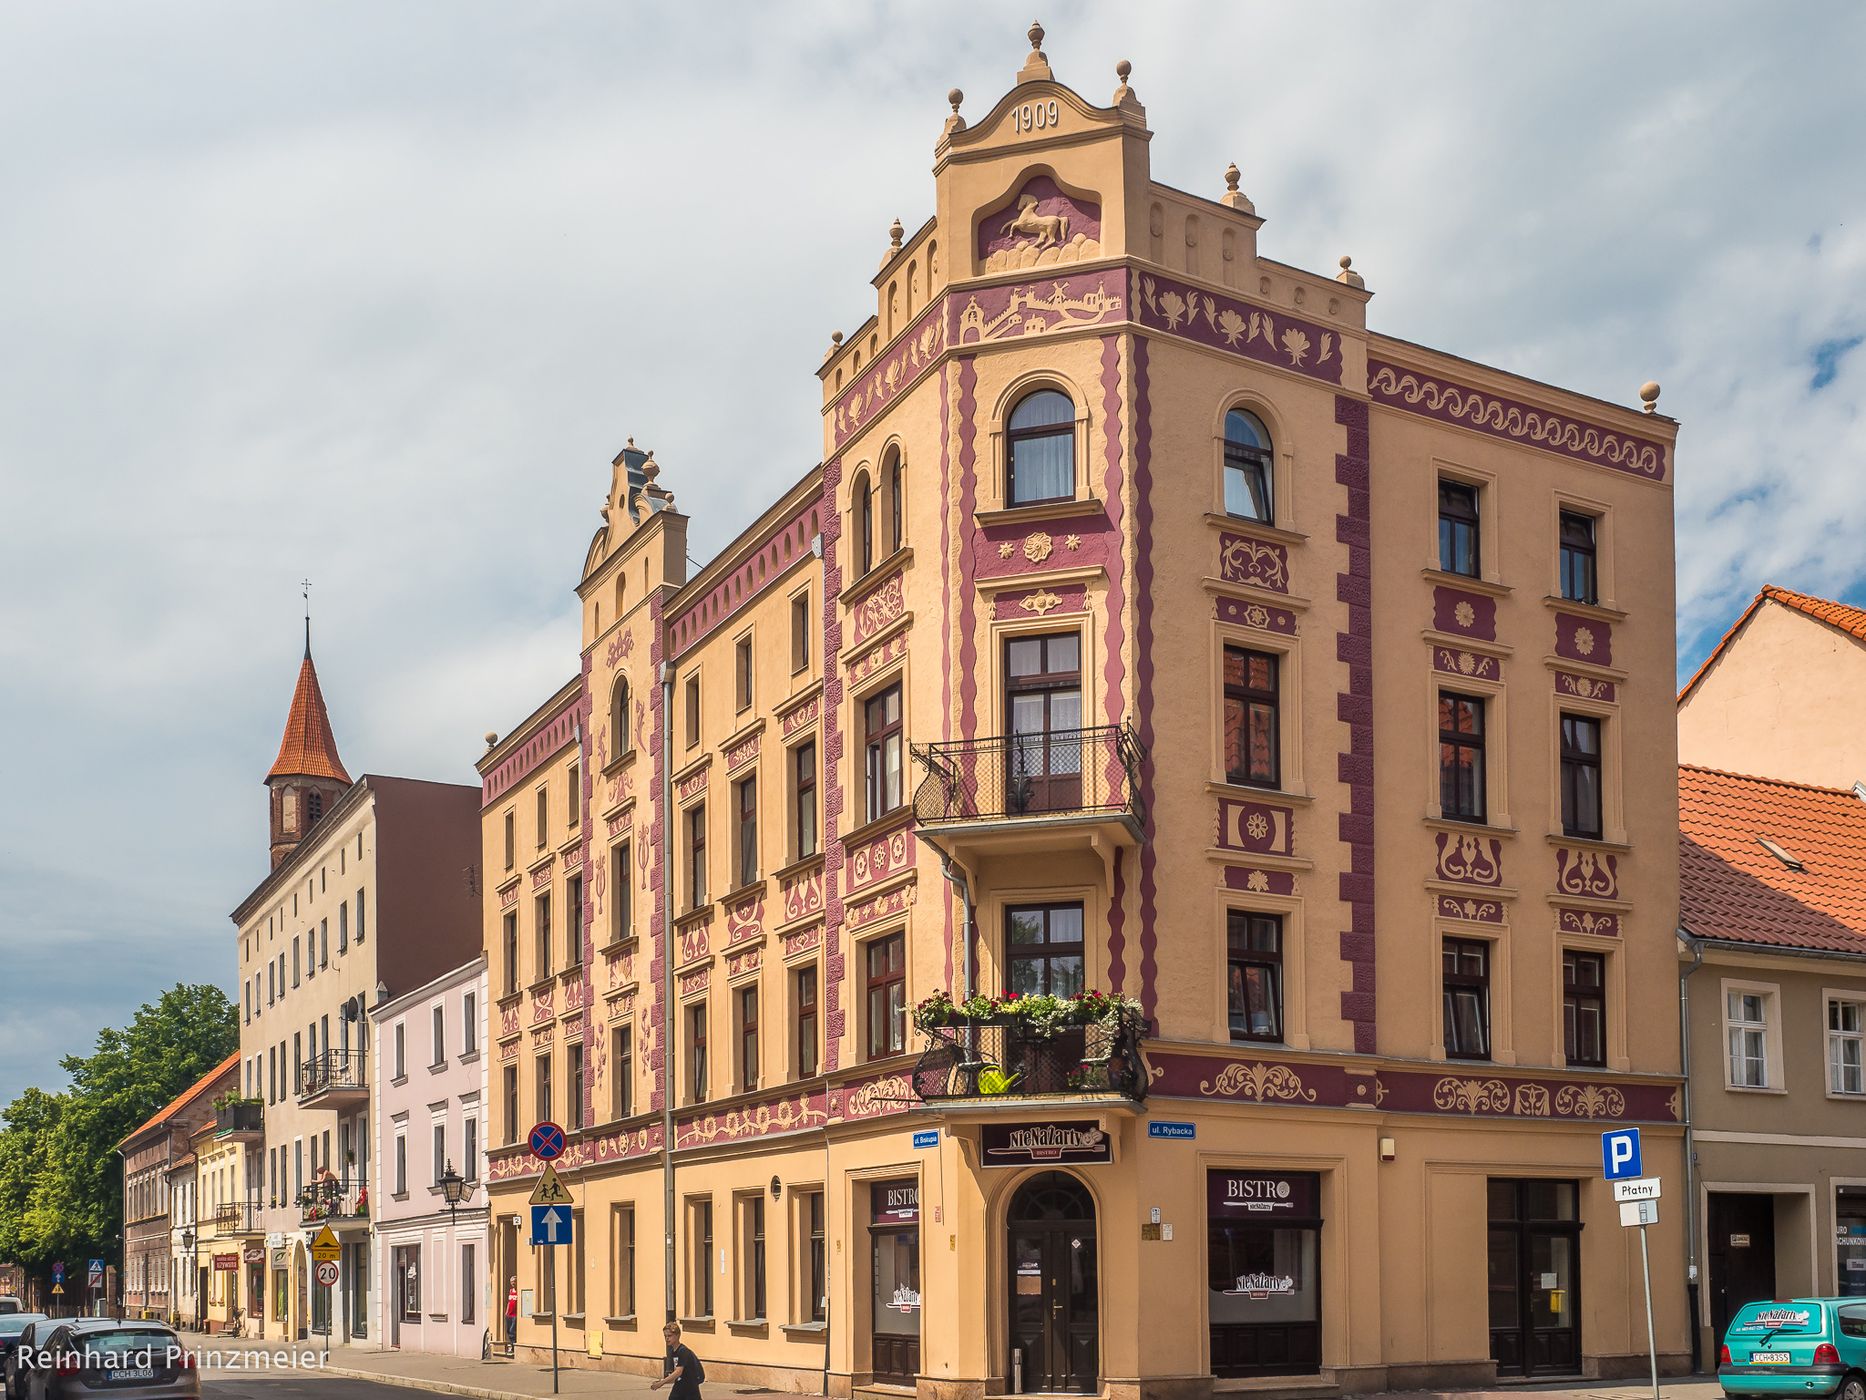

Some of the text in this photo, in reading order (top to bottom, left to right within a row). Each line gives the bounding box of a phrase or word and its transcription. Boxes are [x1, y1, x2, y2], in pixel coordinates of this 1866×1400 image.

[1012, 100, 1058, 131] 1909
[1152, 1126, 1193, 1136] ul. Rybacka
[1610, 1135, 1633, 1174] P
[1227, 1179, 1290, 1199] BISTRO
[1622, 1185, 1653, 1196] Płatny
[320, 1268, 336, 1280] 20
[1755, 1353, 1768, 1361] CCH
